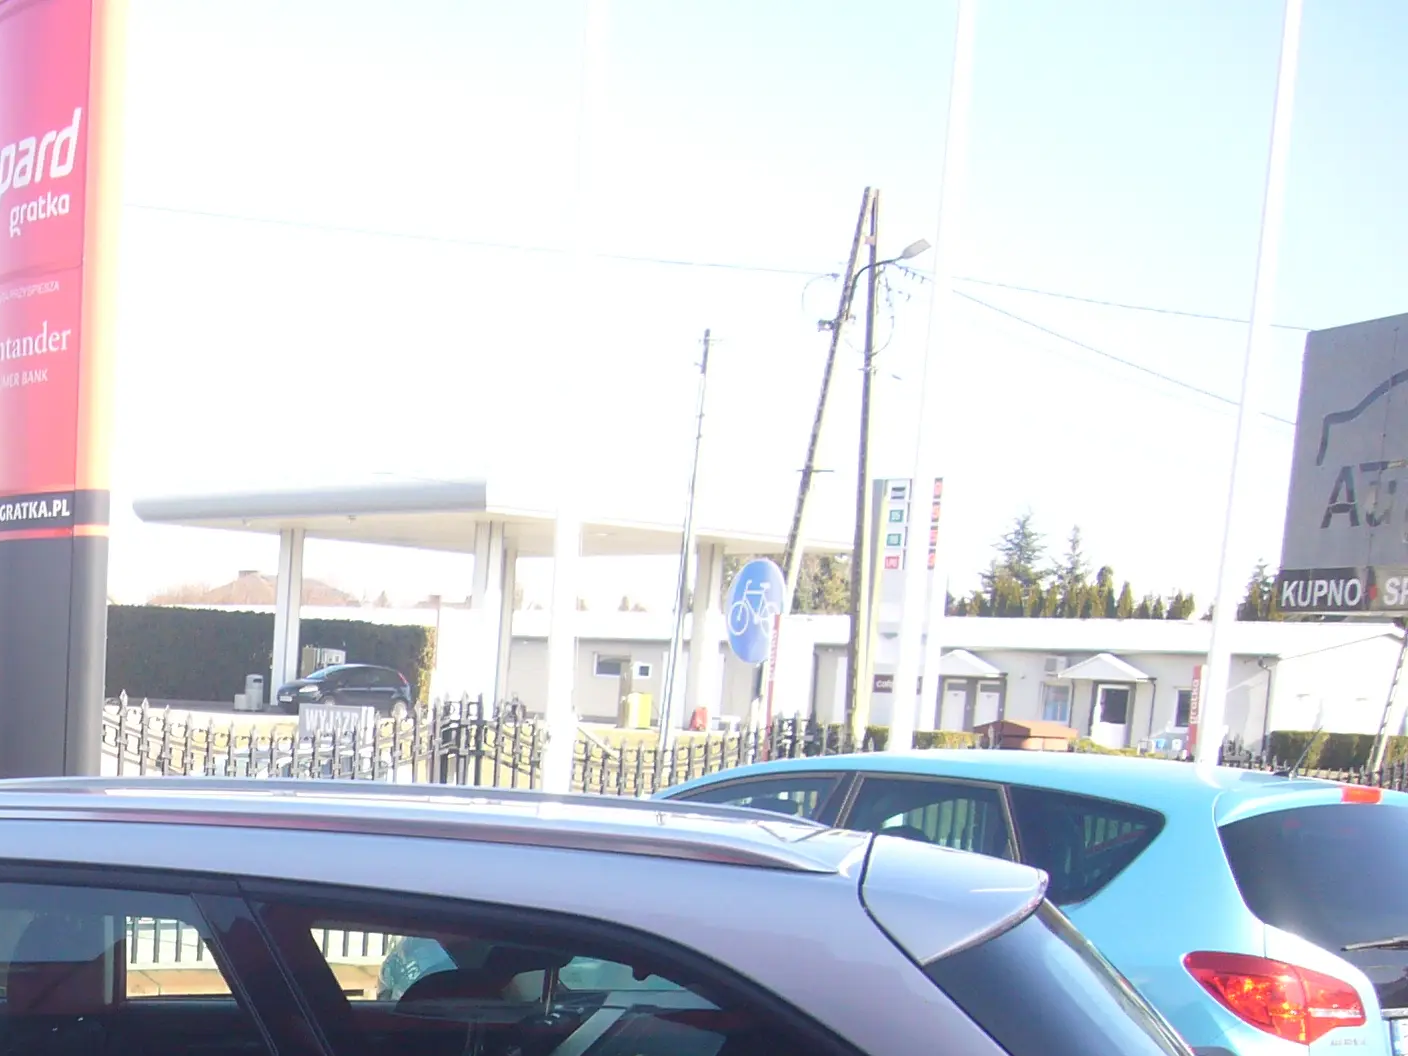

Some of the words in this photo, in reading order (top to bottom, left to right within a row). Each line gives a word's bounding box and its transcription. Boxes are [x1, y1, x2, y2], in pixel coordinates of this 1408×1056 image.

[9, 191, 71, 238] gratka
[21, 368, 50, 386] BANK
[1281, 578, 1362, 607] KUPNO
